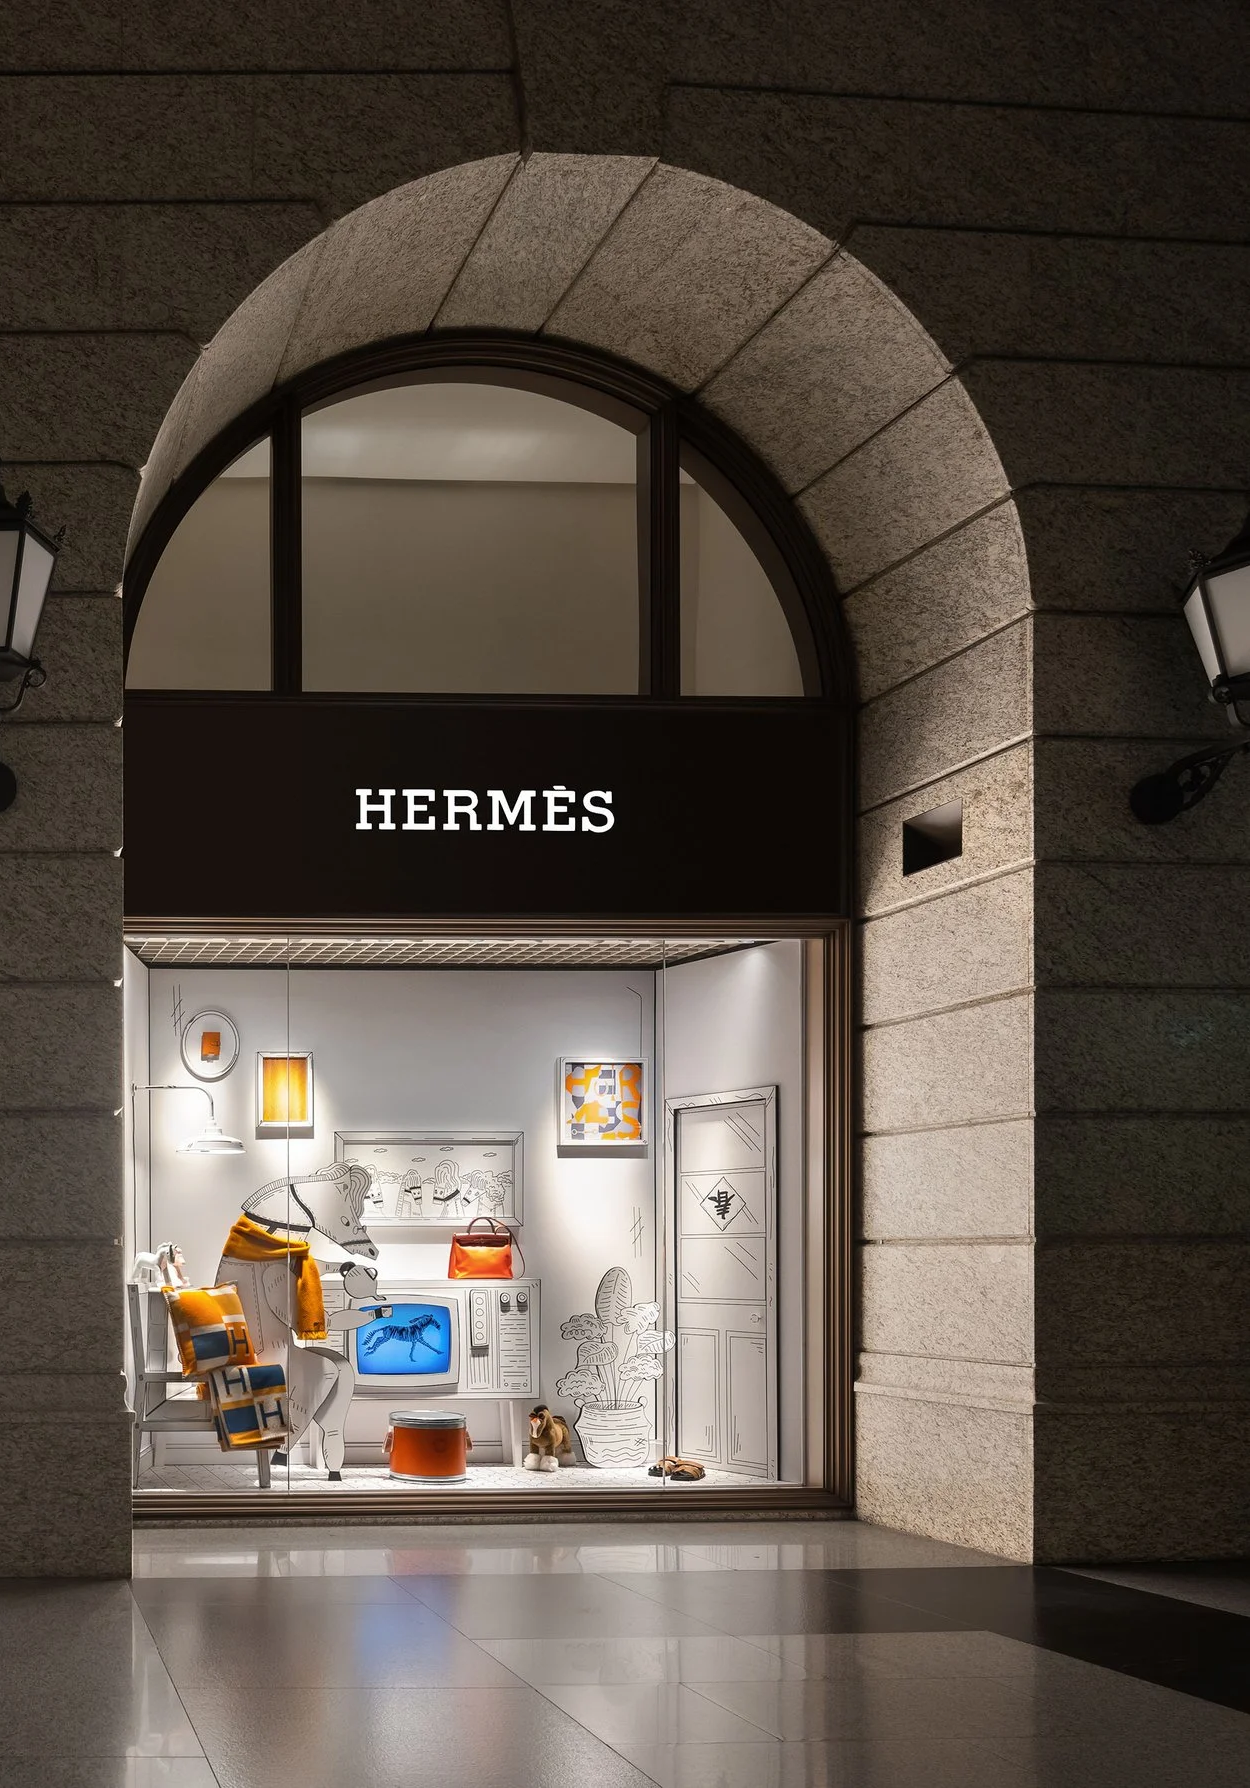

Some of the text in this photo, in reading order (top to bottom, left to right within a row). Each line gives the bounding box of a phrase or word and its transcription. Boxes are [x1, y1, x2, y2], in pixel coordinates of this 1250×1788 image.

[355, 785, 615, 833] HERMÈS
[707, 1189, 736, 1220] 春
[227, 1326, 250, 1357] H
[221, 1368, 249, 1398] H
[256, 1397, 287, 1431] H
